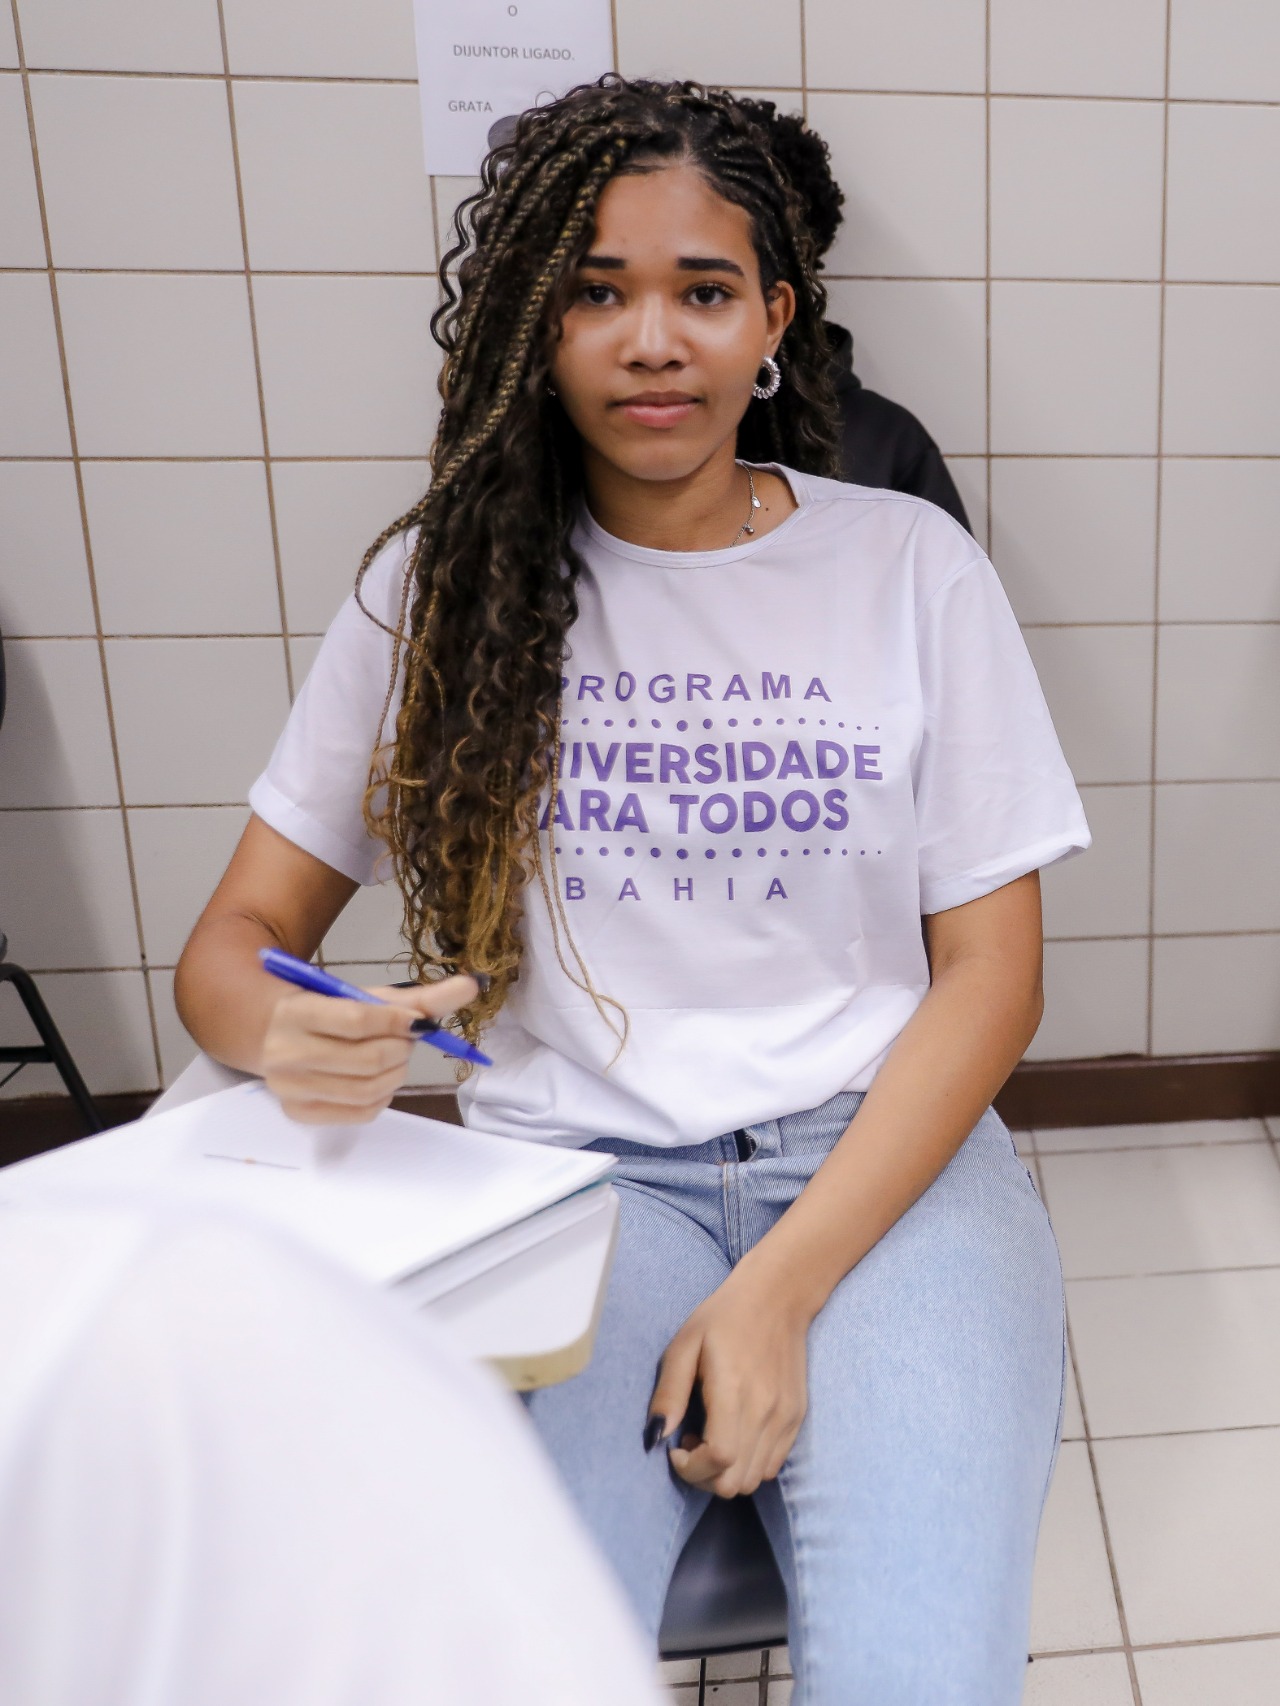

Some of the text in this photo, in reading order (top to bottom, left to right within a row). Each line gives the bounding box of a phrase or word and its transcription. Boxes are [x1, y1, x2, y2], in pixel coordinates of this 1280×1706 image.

[453, 45, 575, 60] DIJUNTOR LIGADO.
[448, 101, 492, 112] GRATA
[546, 740, 883, 784] IVERSIDADE
[537, 788, 849, 834] ARA TODOS
[565, 876, 788, 901] BAHIA
